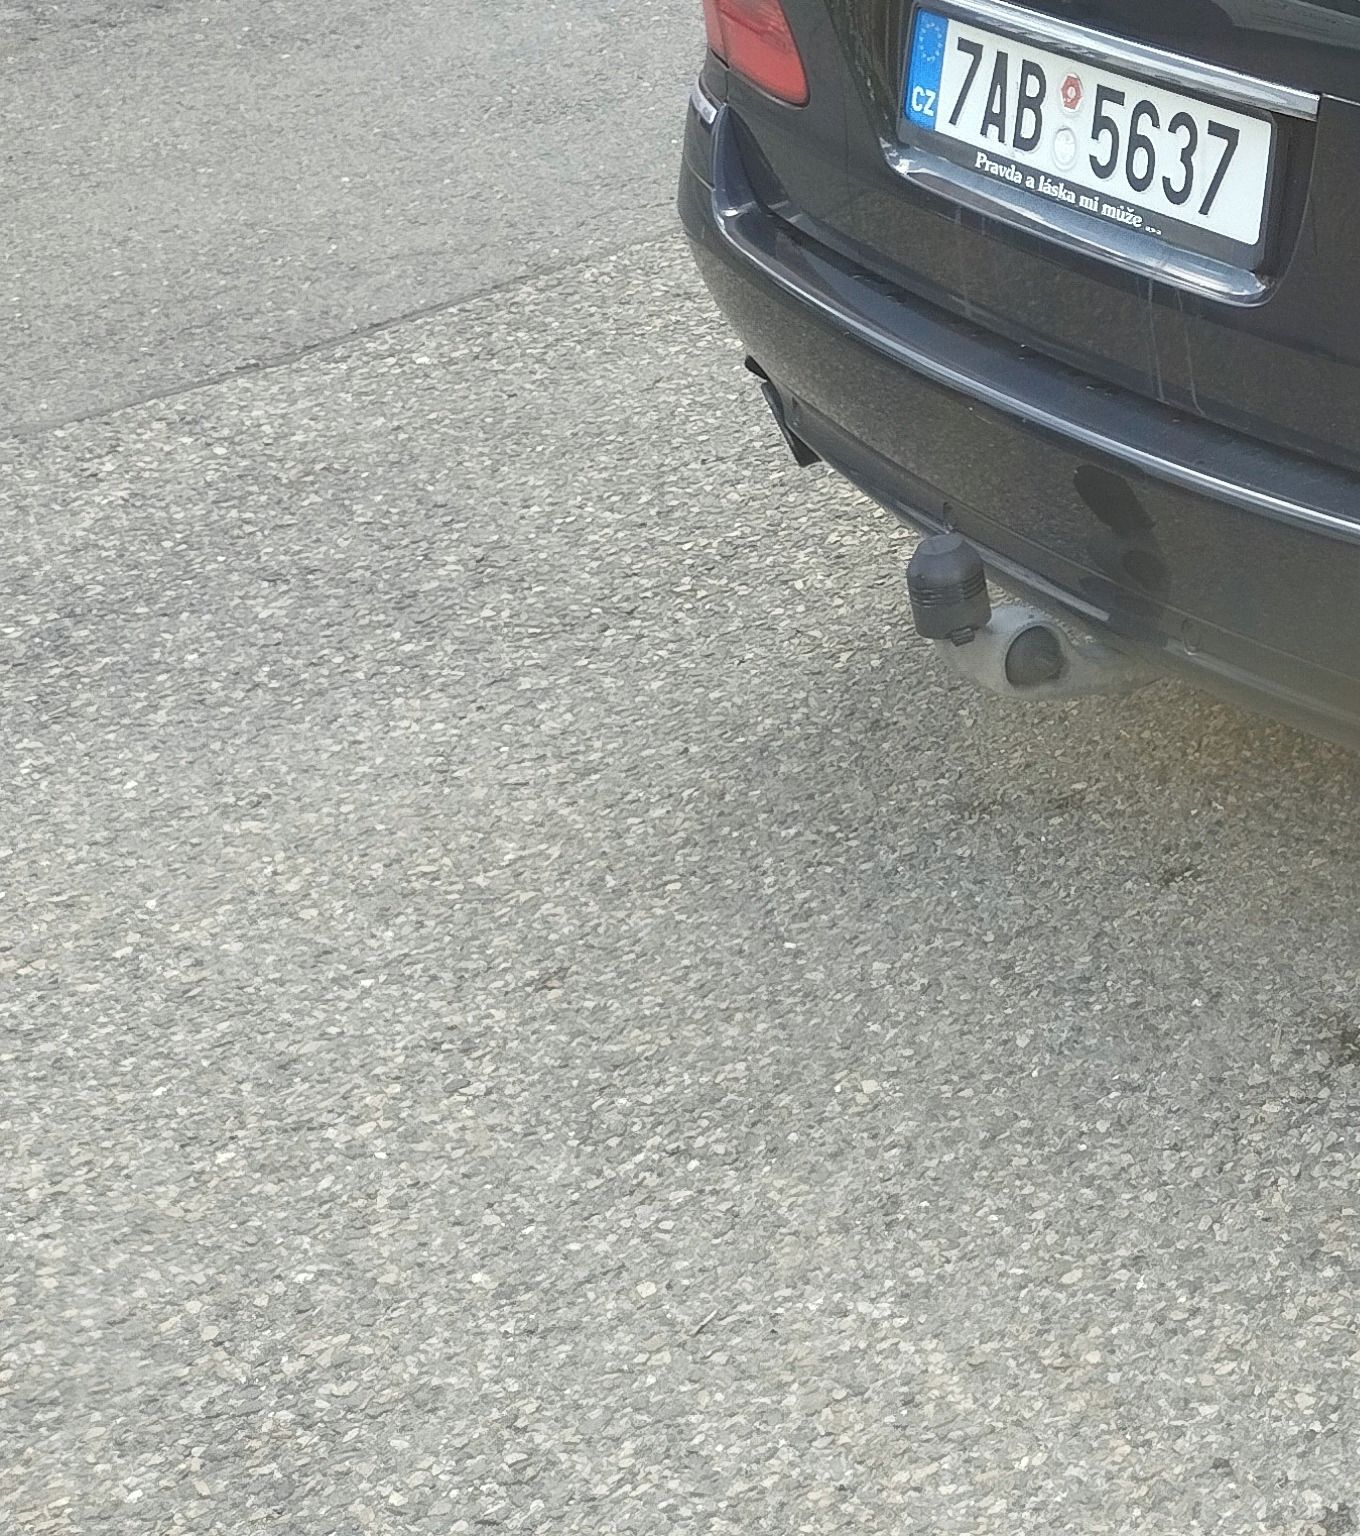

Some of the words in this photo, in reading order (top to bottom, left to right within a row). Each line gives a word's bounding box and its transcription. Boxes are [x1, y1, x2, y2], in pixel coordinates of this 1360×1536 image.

[911, 85, 937, 117] CZ
[948, 36, 1047, 152] 7AB
[1089, 83, 1240, 216] 5637
[974, 151, 1022, 184] Pravda
[1025, 175, 1035, 188] a
[1038, 175, 1076, 204] láska
[1079, 194, 1099, 212] mi
[1101, 204, 1143, 228] může
